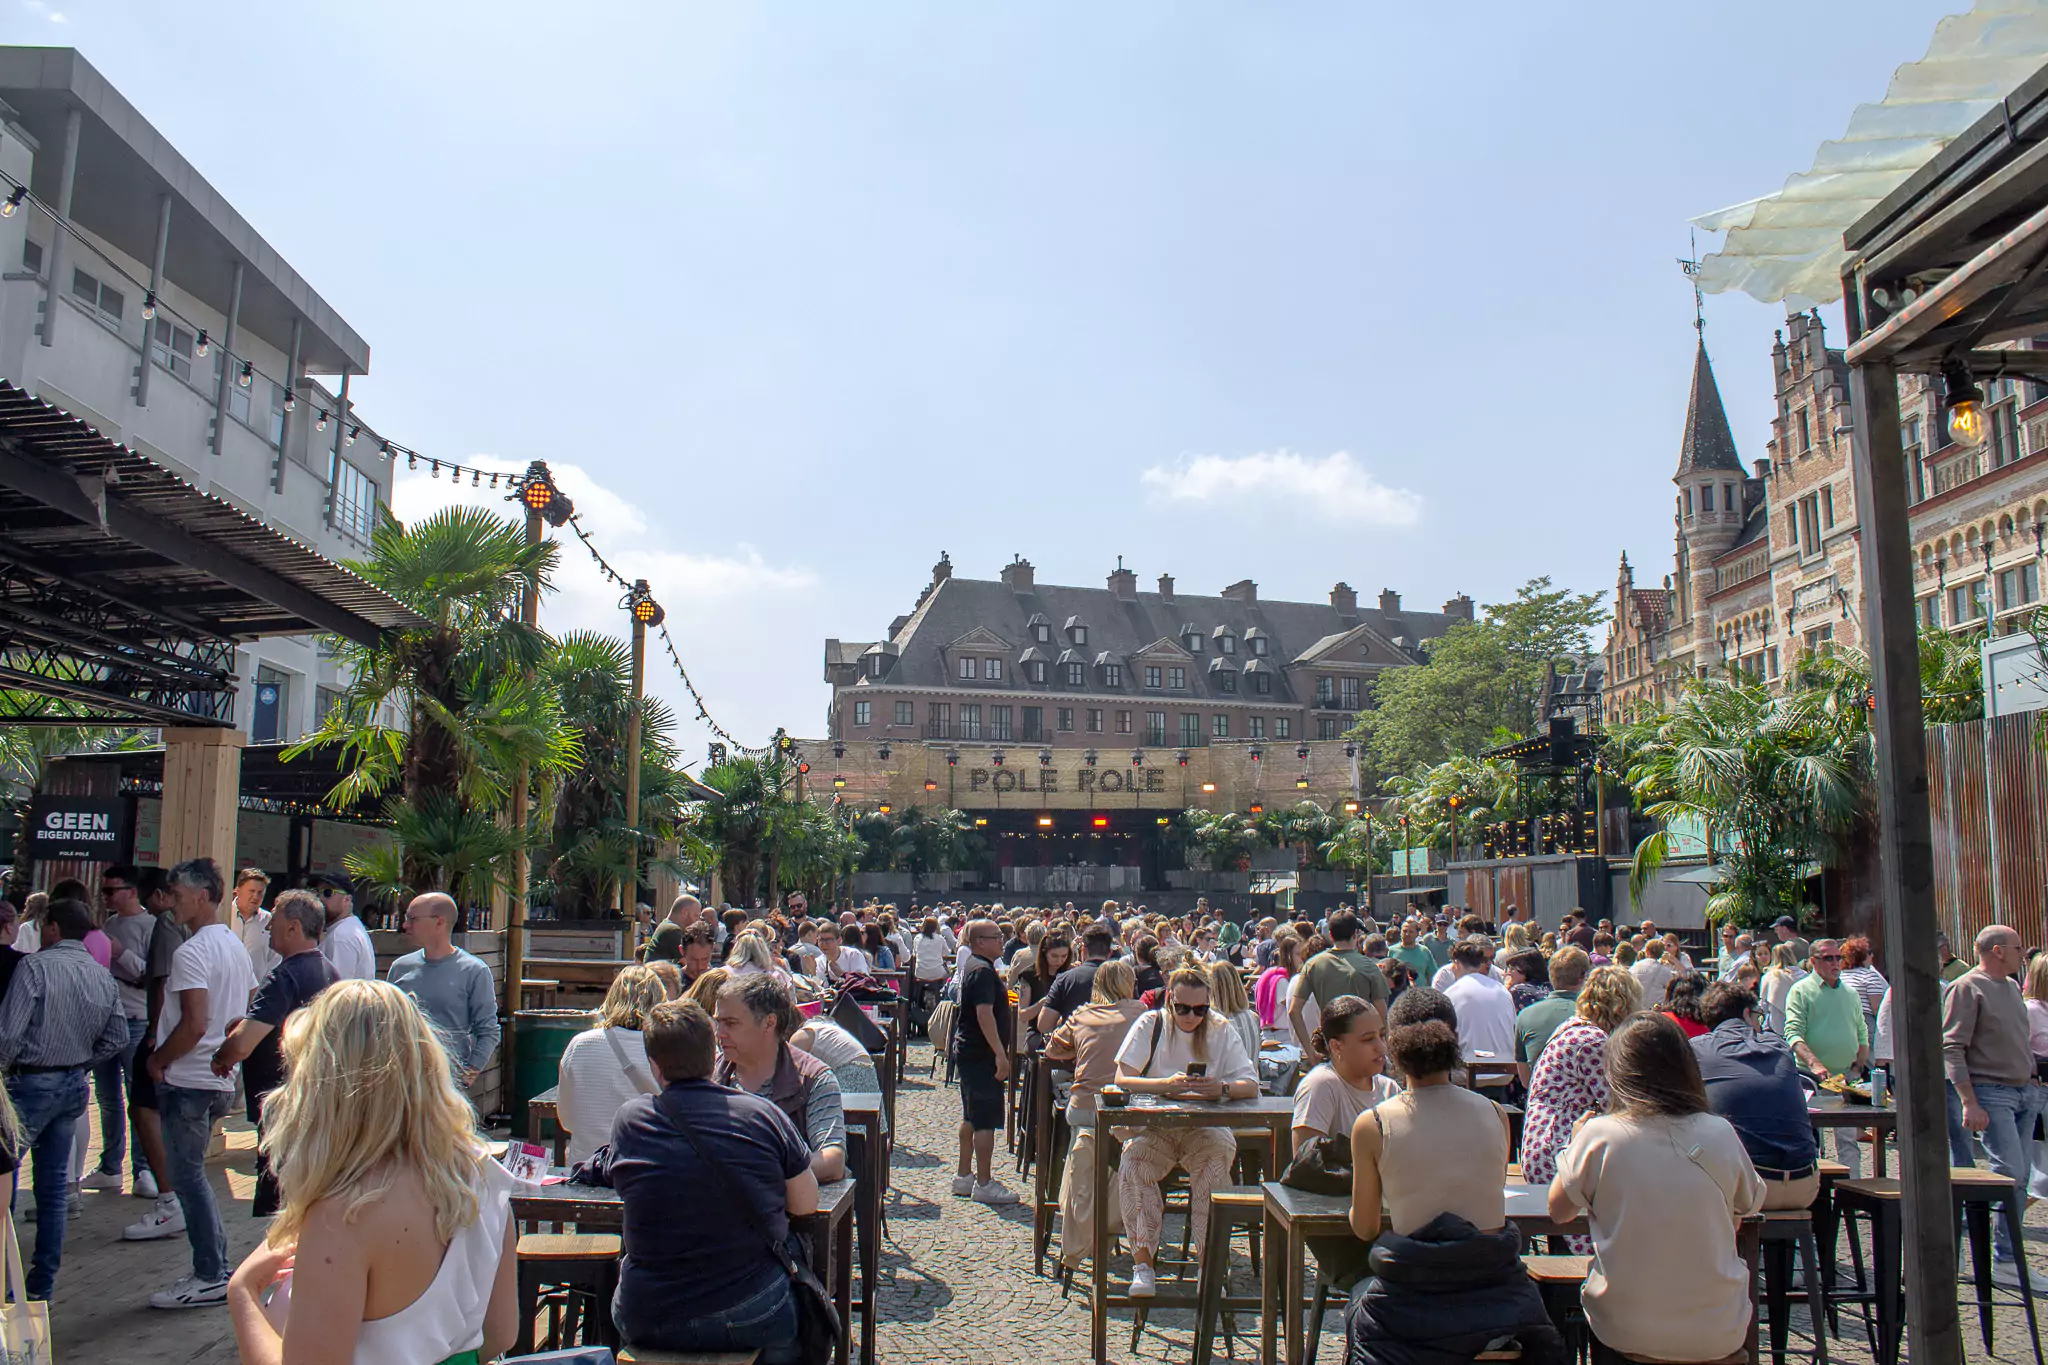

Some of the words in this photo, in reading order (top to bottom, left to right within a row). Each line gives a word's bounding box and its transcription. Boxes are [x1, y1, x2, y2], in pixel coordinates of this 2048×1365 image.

[971, 769, 1058, 792] POLE
[1078, 769, 1164, 792] POLE
[46, 812, 109, 830] GEEN
[37, 830, 71, 839] EIGEN
[73, 832, 115, 841] DRANK!
